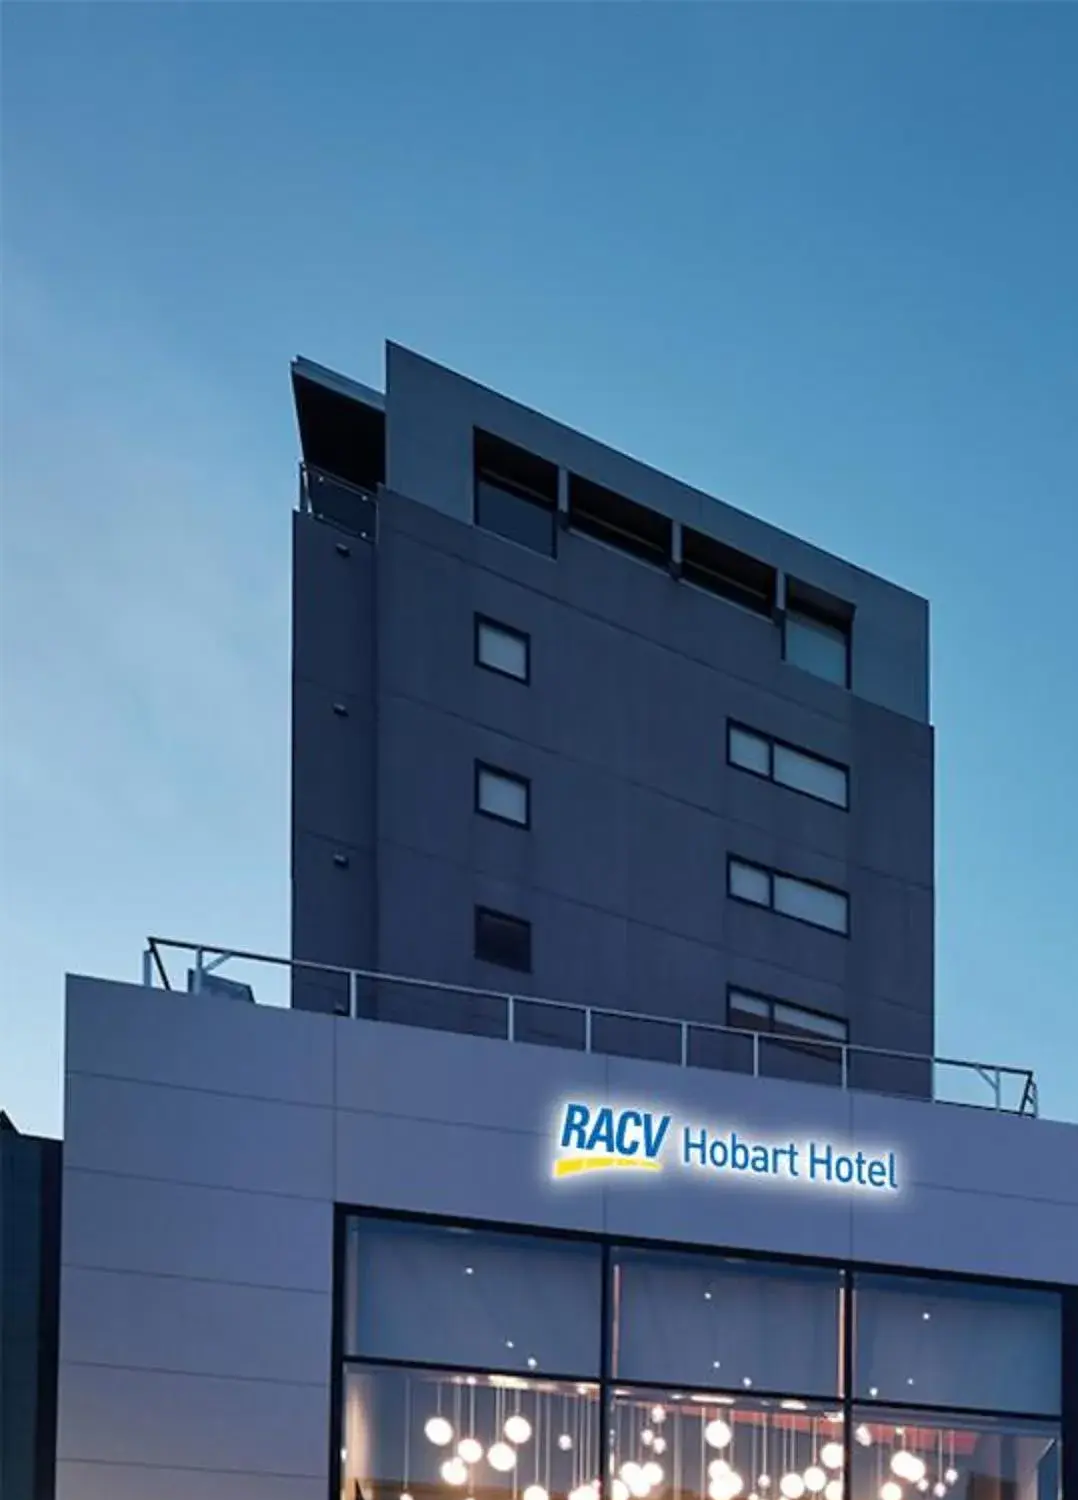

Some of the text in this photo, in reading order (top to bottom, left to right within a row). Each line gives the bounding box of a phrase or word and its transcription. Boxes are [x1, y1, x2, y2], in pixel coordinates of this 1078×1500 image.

[560, 1103, 899, 1188] RACV Hobart Hotel
